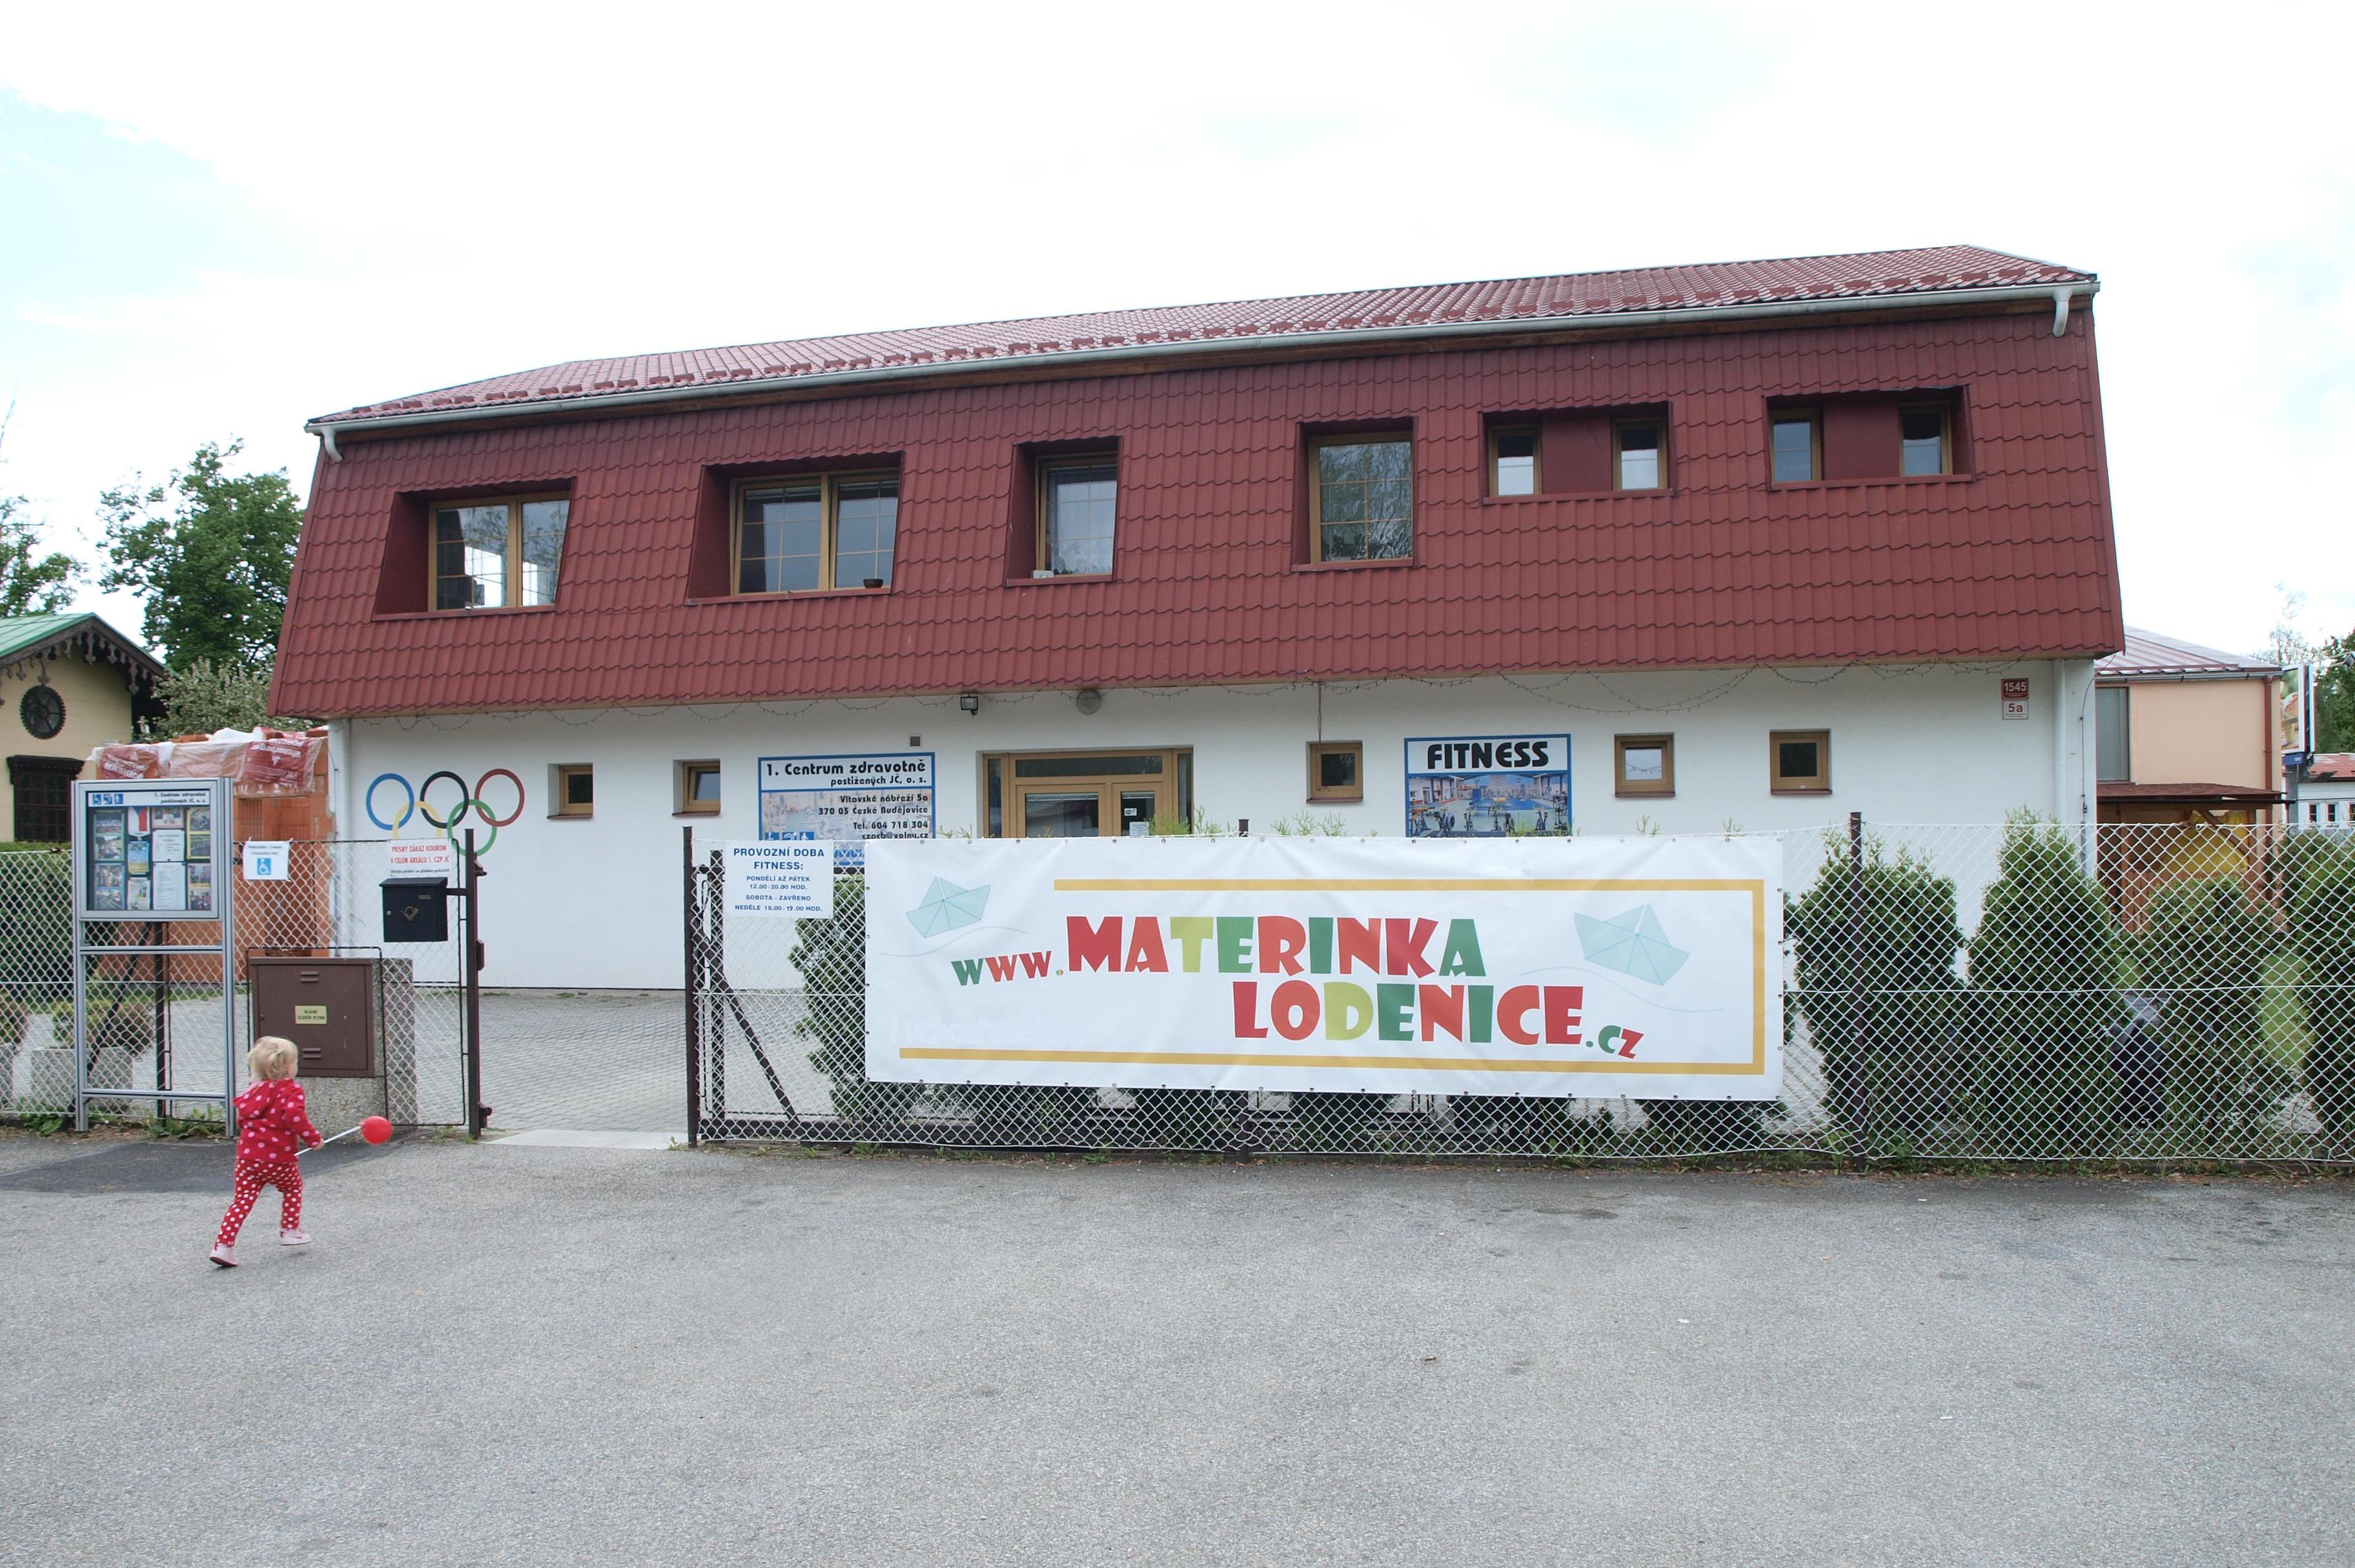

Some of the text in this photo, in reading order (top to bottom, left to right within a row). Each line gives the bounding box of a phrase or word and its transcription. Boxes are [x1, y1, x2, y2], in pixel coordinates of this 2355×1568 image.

[2004, 681, 2027, 693] 1545
[2008, 703, 2023, 713] 5a
[1427, 740, 1549, 770] FITNESS
[766, 759, 926, 776] 1. Centrum zdravotně
[830, 775, 886, 788] postižených
[890, 773, 902, 785] JČ,
[840, 794, 877, 803] Vltavské
[880, 793, 914, 802] nábřeží
[853, 804, 877, 815] České
[881, 806, 928, 815] Budějovice
[853, 822, 868, 830] Tel.
[912, 820, 928, 829] 304
[733, 846, 824, 857] PROVOZNÍ DOBA
[753, 861, 804, 870] FITNESS:
